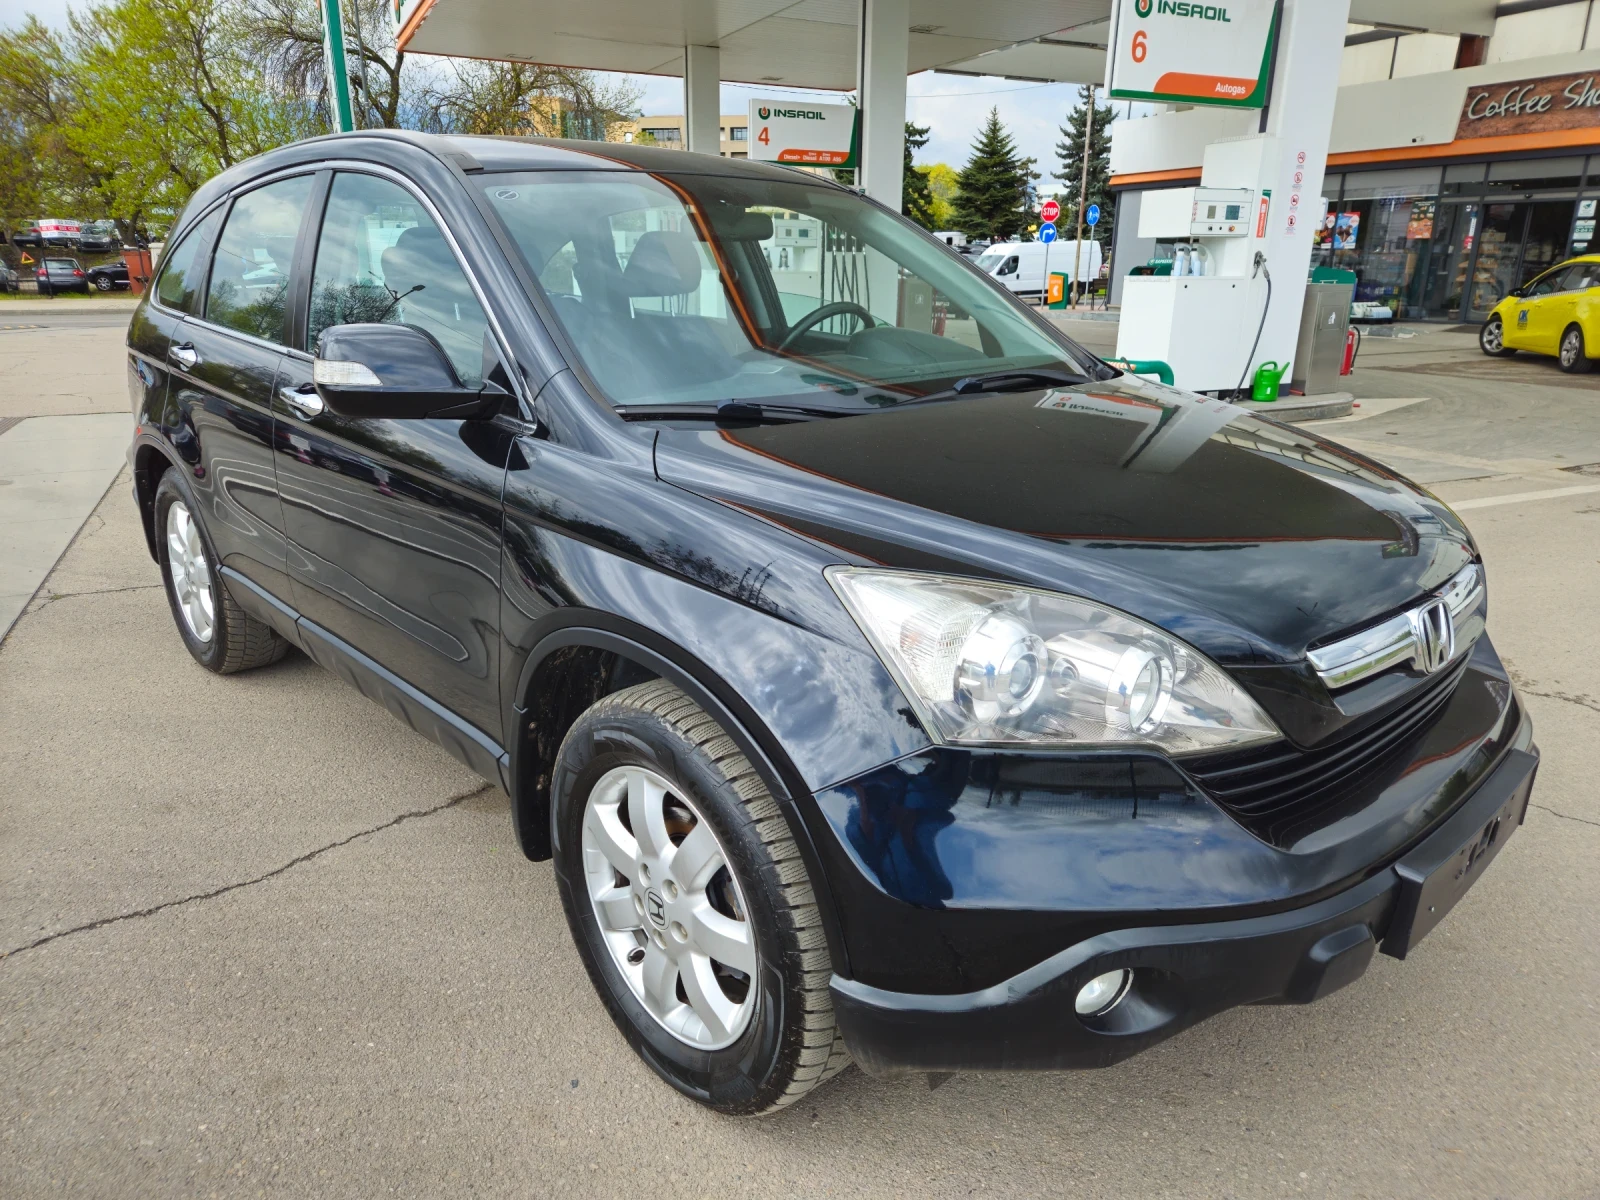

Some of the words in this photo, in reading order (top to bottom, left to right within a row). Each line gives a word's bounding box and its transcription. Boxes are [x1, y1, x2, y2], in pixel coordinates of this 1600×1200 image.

[1157, 0, 1231, 22] INSAOIL
[1131, 30, 1147, 63] 6
[1215, 82, 1246, 96] Autogas
[1468, 84, 1552, 120] Coffee
[774, 109, 826, 120] INSAOIL
[758, 127, 770, 146] 4
[1043, 207, 1058, 216] STOP
